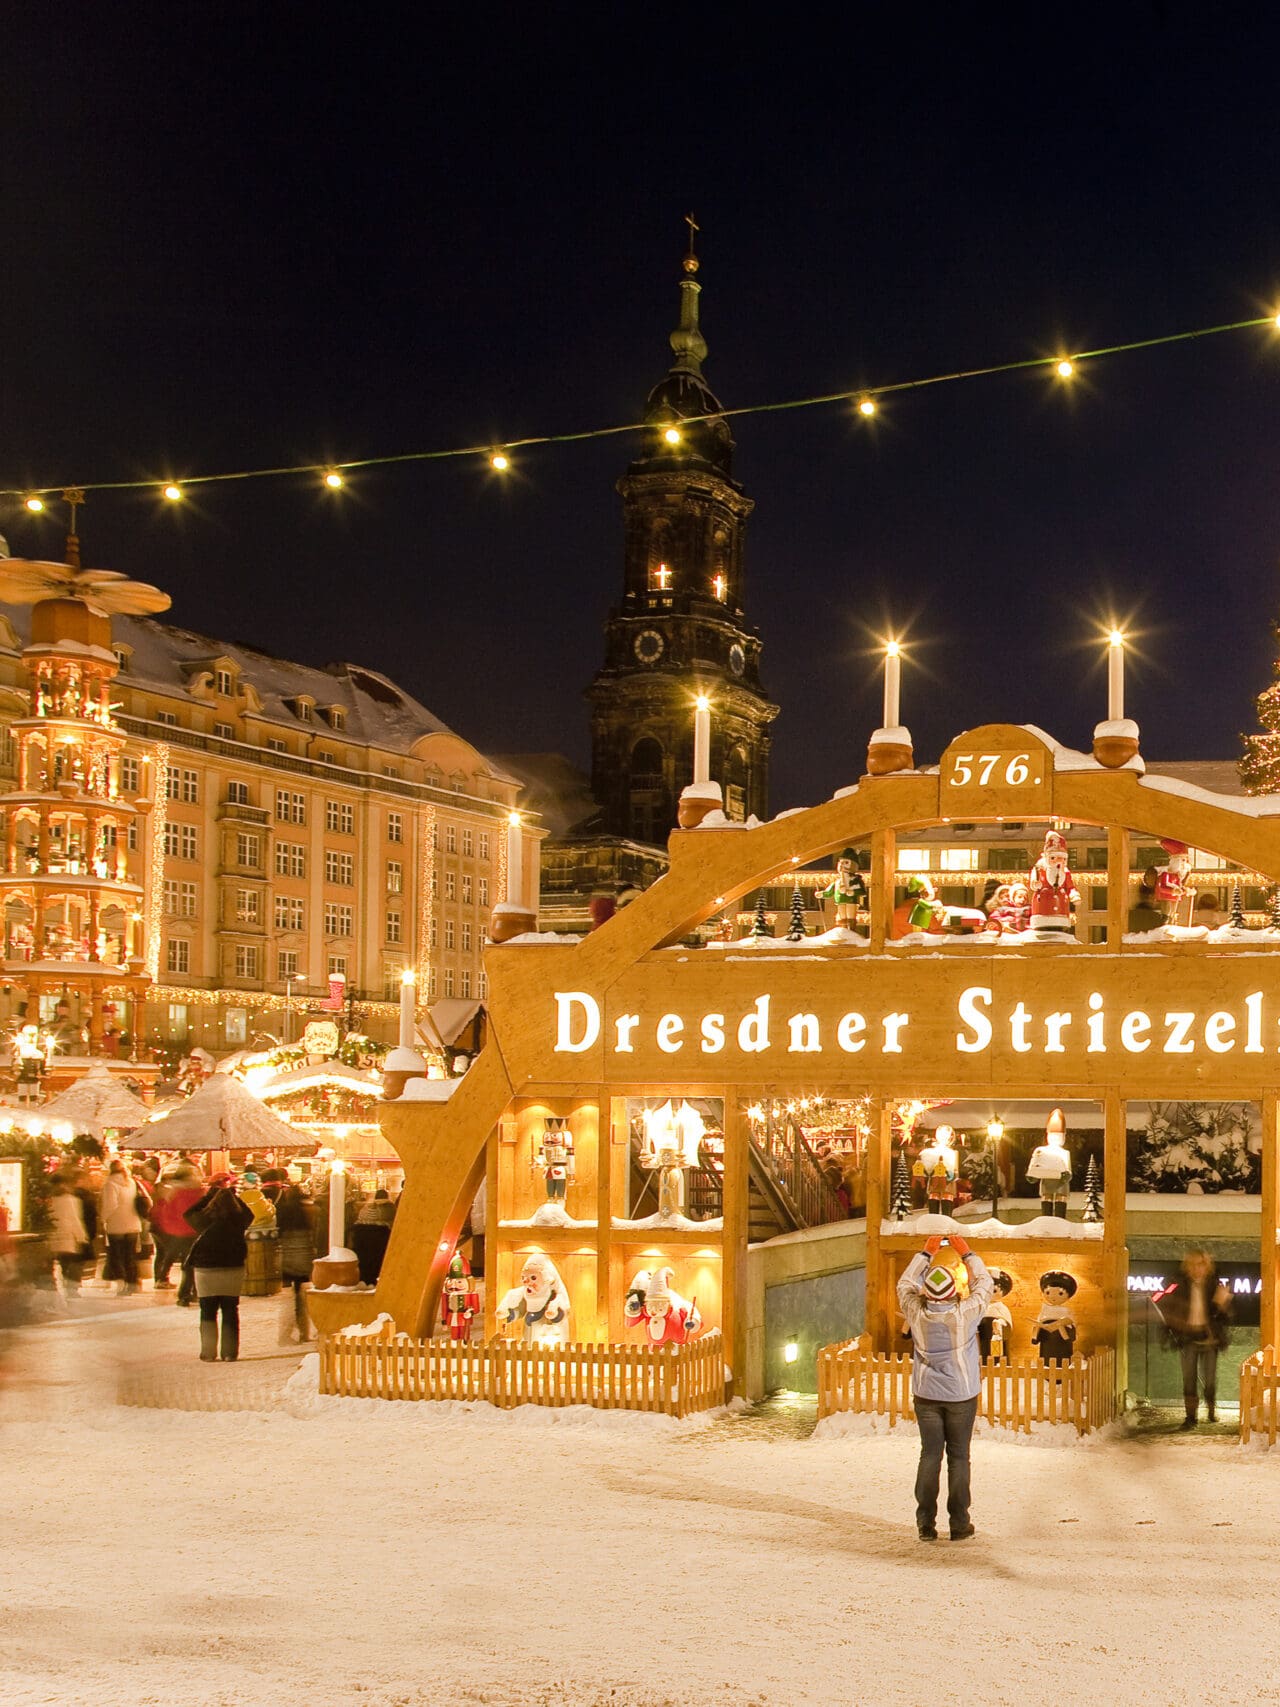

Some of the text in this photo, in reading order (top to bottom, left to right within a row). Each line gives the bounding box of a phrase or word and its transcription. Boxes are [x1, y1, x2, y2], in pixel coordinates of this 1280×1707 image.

[950, 754, 1041, 786] 576.
[553, 991, 909, 1053] Dresdner
[1127, 1275, 1165, 1292] PARK
